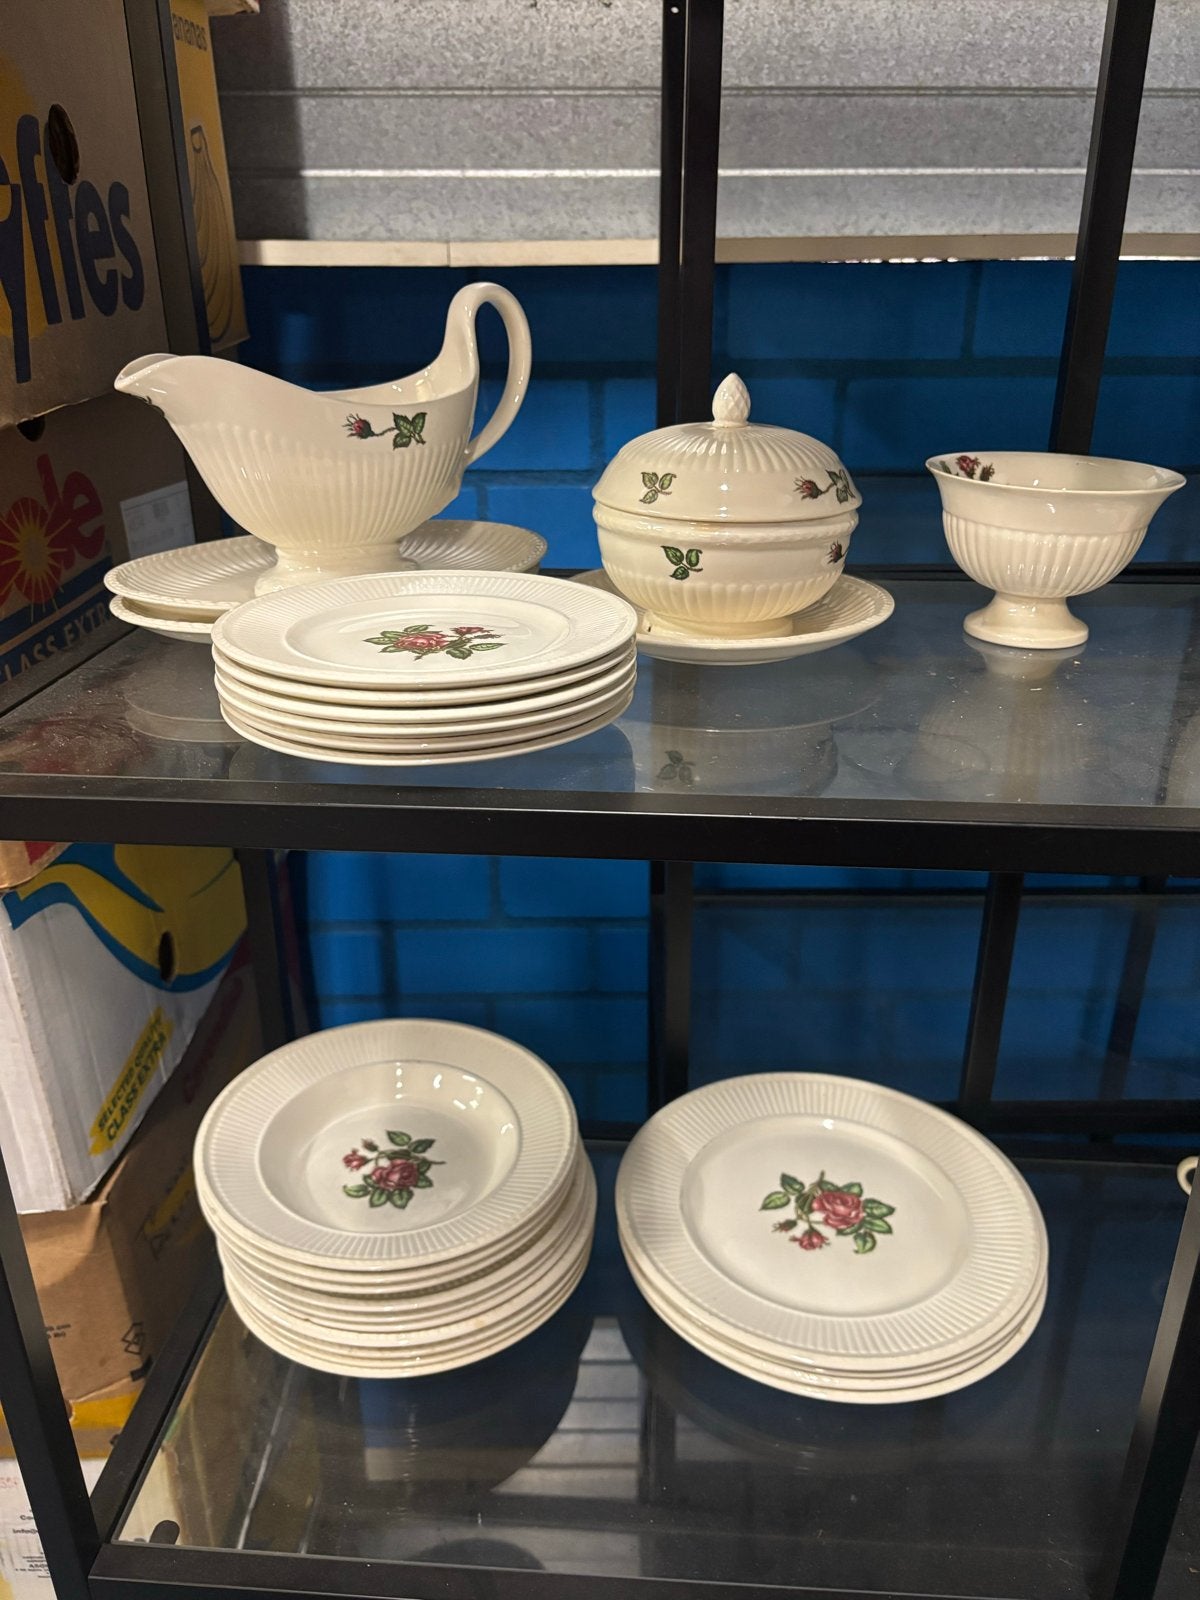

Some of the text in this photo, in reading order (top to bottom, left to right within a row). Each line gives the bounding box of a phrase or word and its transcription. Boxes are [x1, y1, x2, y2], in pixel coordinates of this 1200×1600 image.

[172, 12, 208, 51] ananas
[0, 114, 145, 383] yffes
[0, 453, 105, 608] ole
[0, 601, 111, 683] LASS EXTR
[107, 1030, 168, 1142] CLASS EXTRA
